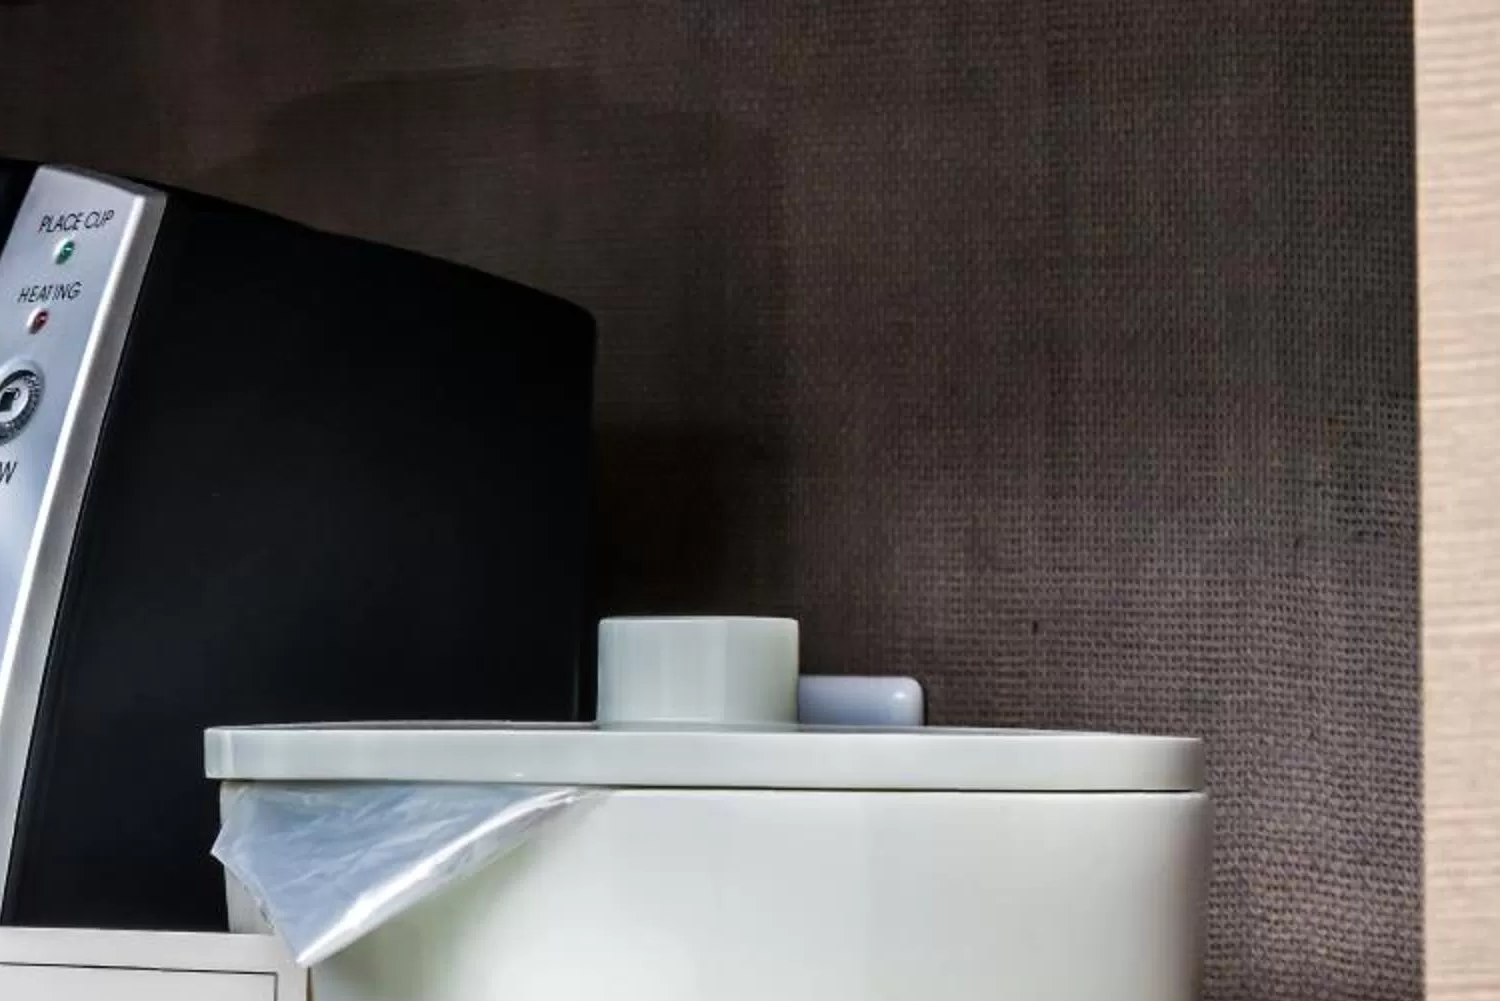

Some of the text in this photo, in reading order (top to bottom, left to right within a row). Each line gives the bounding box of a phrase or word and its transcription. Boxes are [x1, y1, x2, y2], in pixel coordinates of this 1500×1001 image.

[38, 209, 115, 233] PLACE CUP
[17, 281, 84, 303] HEATING
